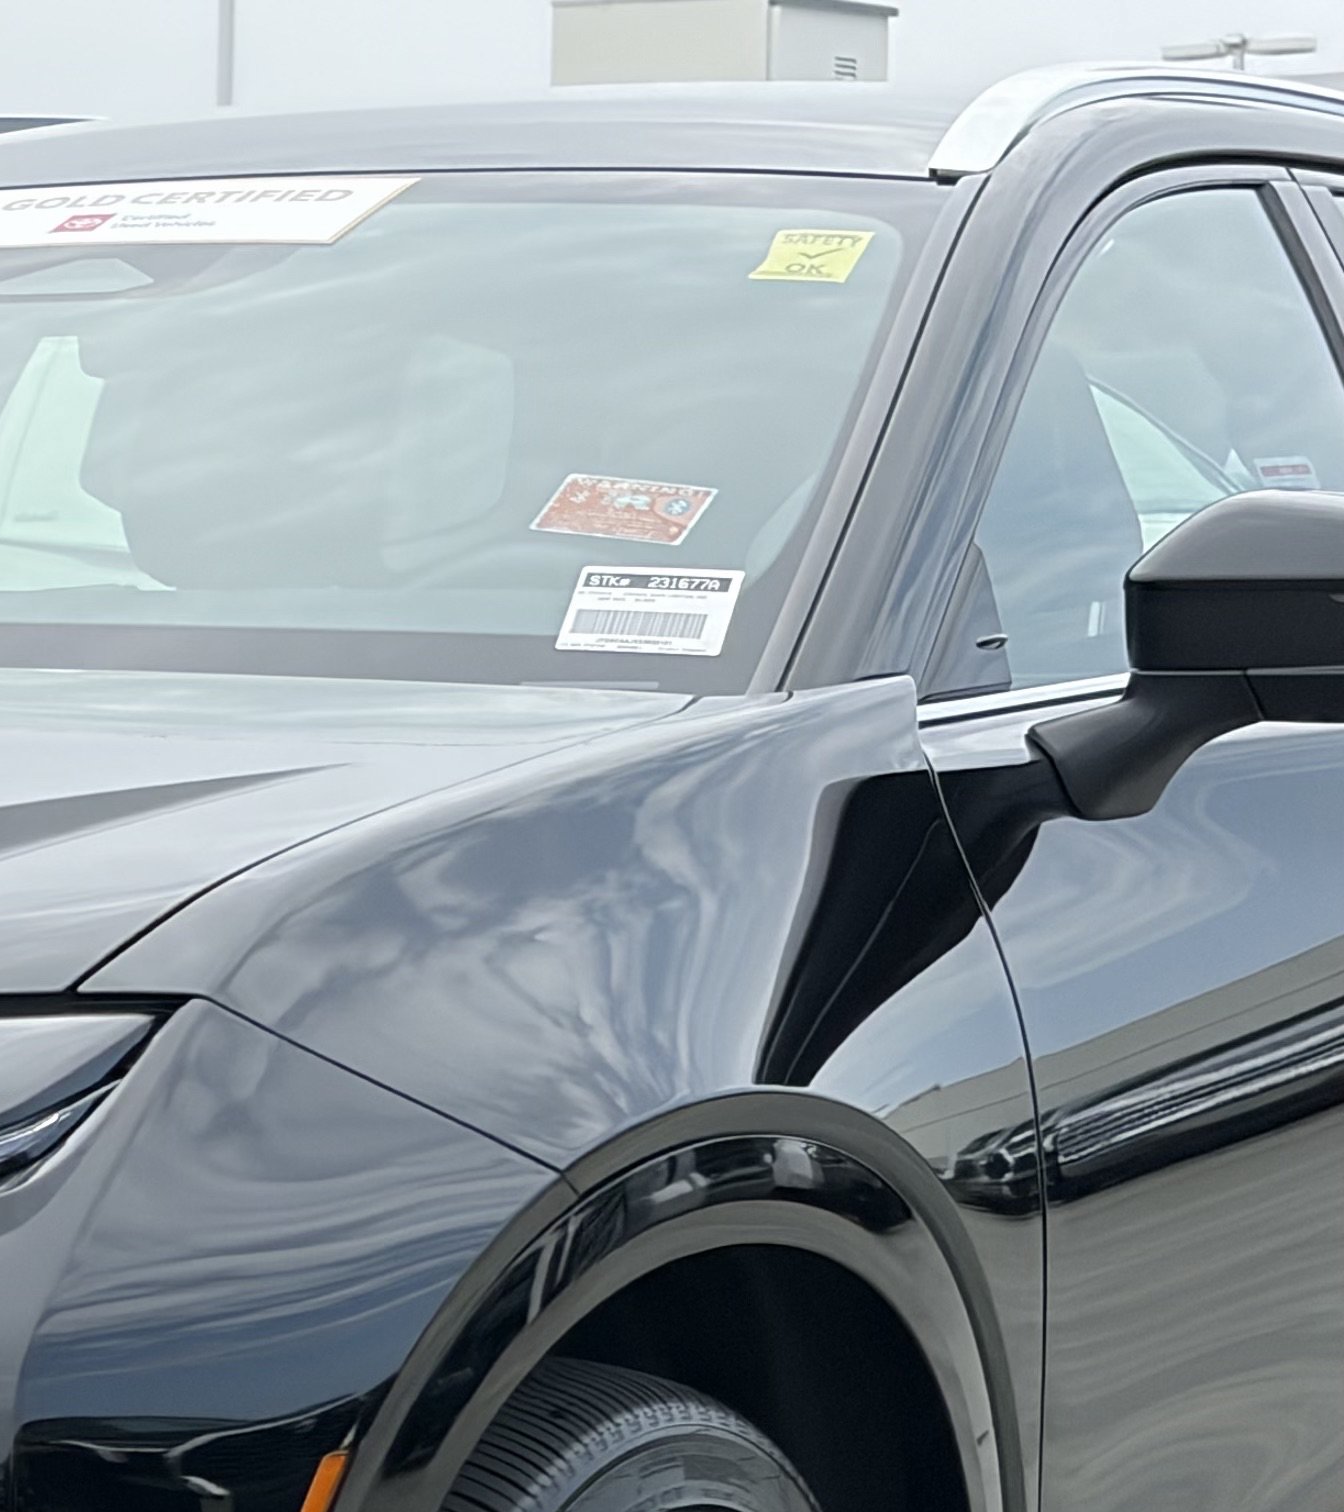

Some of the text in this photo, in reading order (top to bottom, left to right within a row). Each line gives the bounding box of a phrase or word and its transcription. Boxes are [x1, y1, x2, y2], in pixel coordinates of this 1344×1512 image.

[1, 189, 355, 212] GOLD CERTIFIED
[782, 232, 864, 248] SAFETY
[784, 263, 826, 275] OK
[647, 576, 721, 591] 231677A
